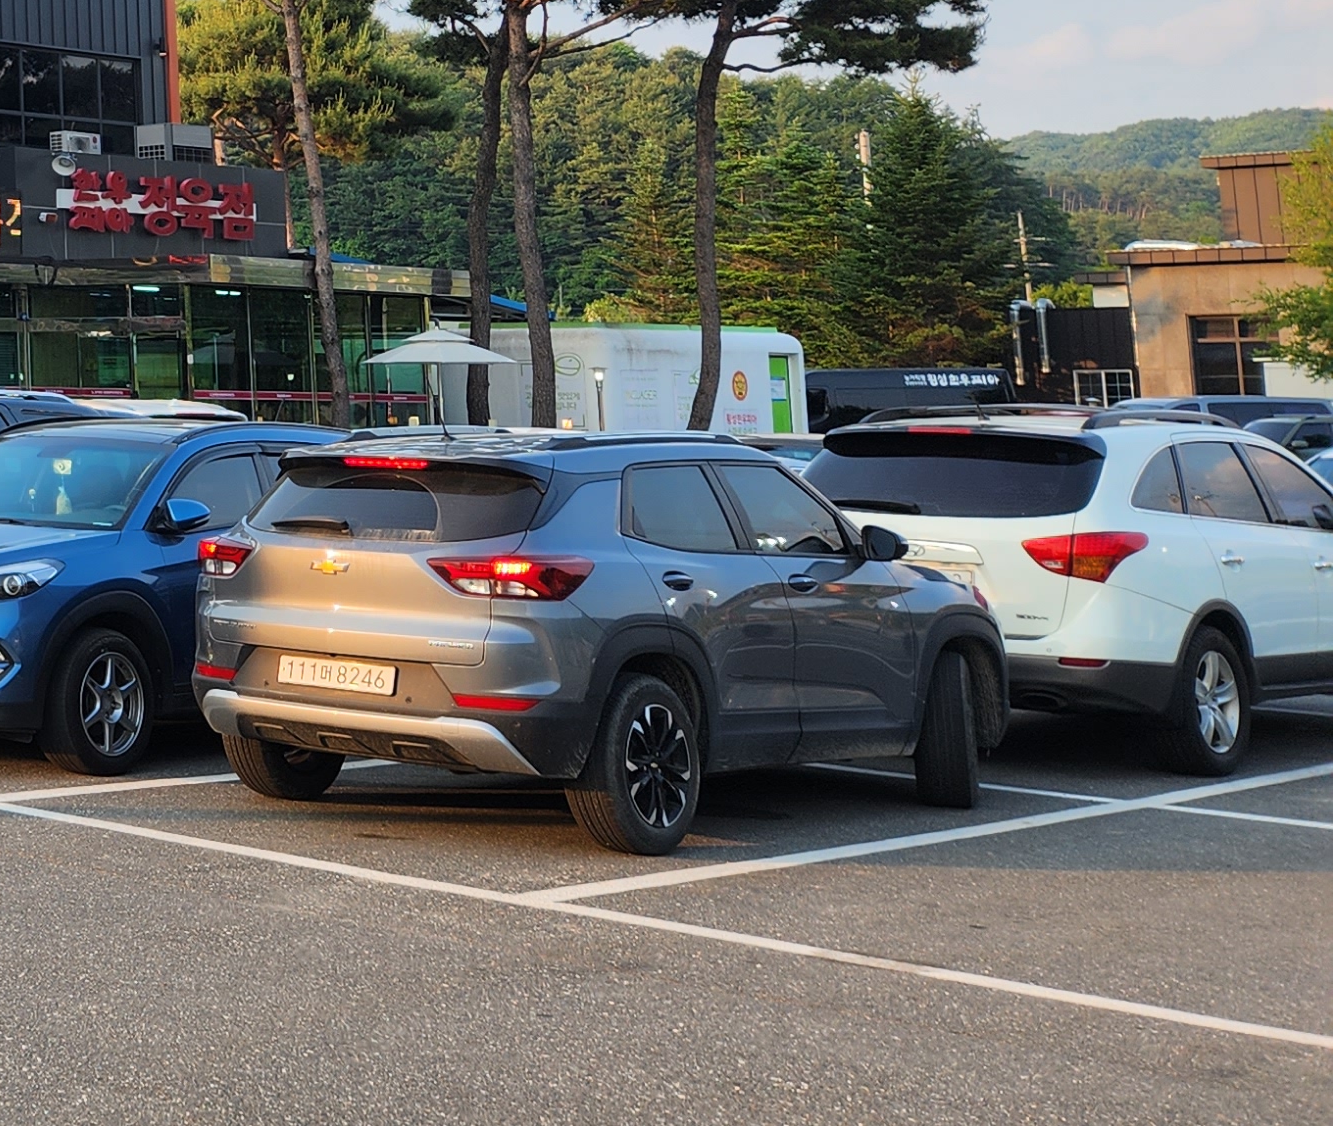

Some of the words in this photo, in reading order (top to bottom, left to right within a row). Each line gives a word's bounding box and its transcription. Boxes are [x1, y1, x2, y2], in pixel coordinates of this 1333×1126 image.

[70, 167, 132, 204] 한우
[69, 205, 135, 234] 피아
[138, 175, 255, 241] 정육점
